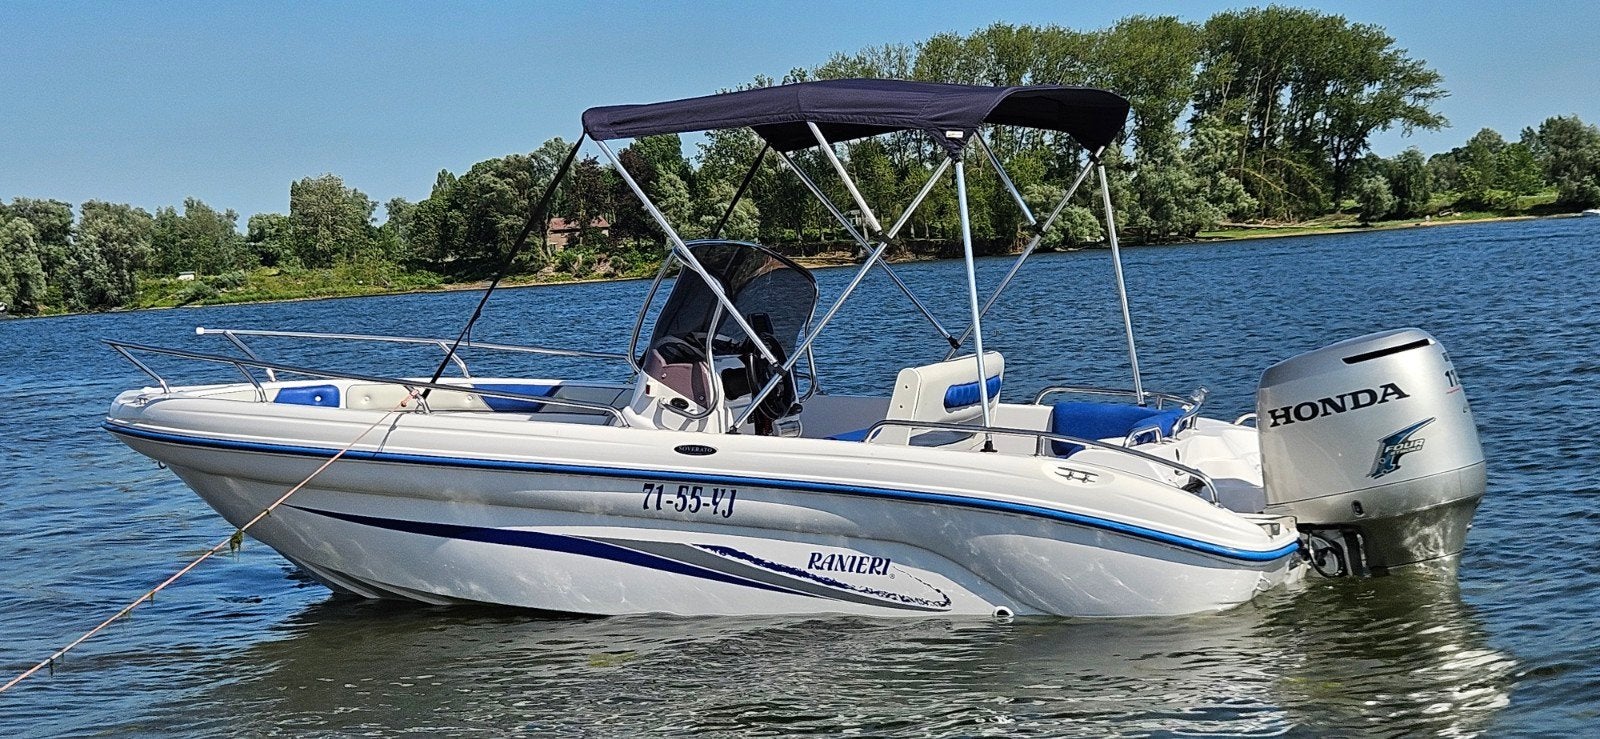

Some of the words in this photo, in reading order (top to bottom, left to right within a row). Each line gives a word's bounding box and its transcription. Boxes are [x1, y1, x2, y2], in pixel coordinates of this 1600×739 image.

[1268, 382, 1410, 428] HONDA
[1385, 439, 1424, 453] FOUR
[642, 483, 737, 518] 71-55-YJ
[808, 552, 891, 576] RANIERI
